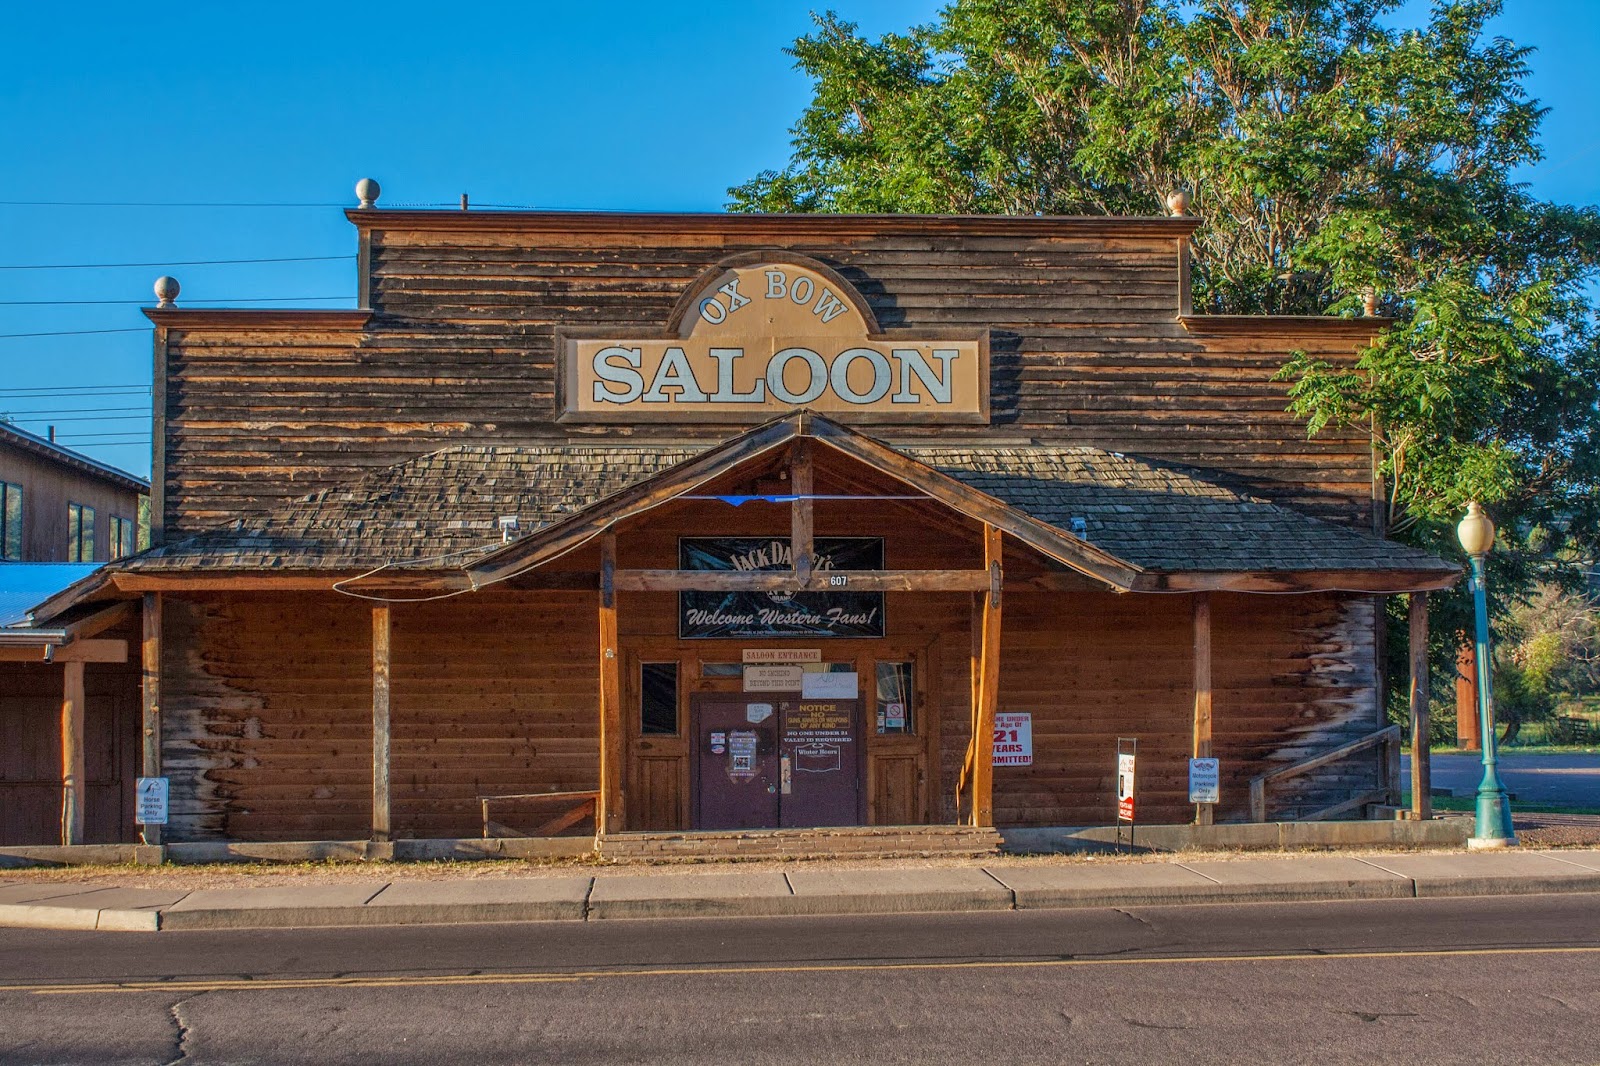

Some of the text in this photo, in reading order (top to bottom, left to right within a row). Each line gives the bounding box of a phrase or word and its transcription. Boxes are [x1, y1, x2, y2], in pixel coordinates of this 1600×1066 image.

[699, 270, 849, 326] OX BOW
[592, 346, 960, 404] SALOON
[729, 541, 835, 571] JACK DAEL'S
[830, 576, 847, 586] 607
[686, 607, 877, 627] Welcome Western Fans!
[746, 651, 818, 659] SALOON ENTRANCE
[993, 730, 1018, 742] 21
[992, 755, 1032, 763] RMITTED!
